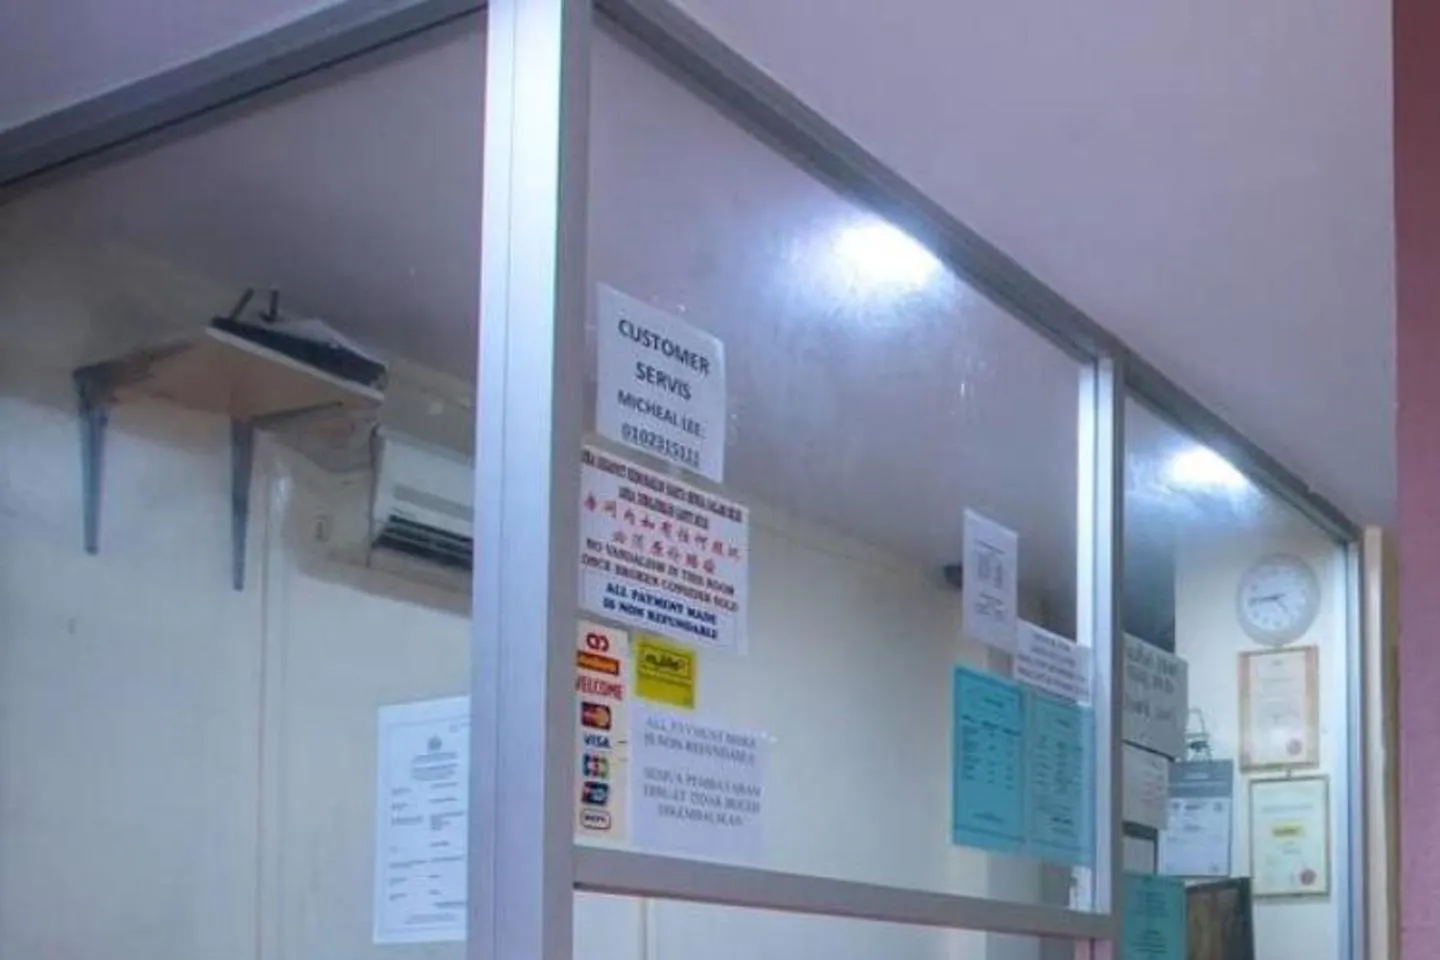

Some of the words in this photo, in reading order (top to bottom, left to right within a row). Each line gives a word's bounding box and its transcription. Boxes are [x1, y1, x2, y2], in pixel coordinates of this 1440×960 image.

[618, 319, 710, 376] CUSTOMER
[636, 361, 692, 400] SERVIS
[605, 582, 627, 597] ALL
[631, 588, 684, 613] PAYMENT
[686, 606, 717, 625] MADE
[584, 733, 611, 748] VISA
